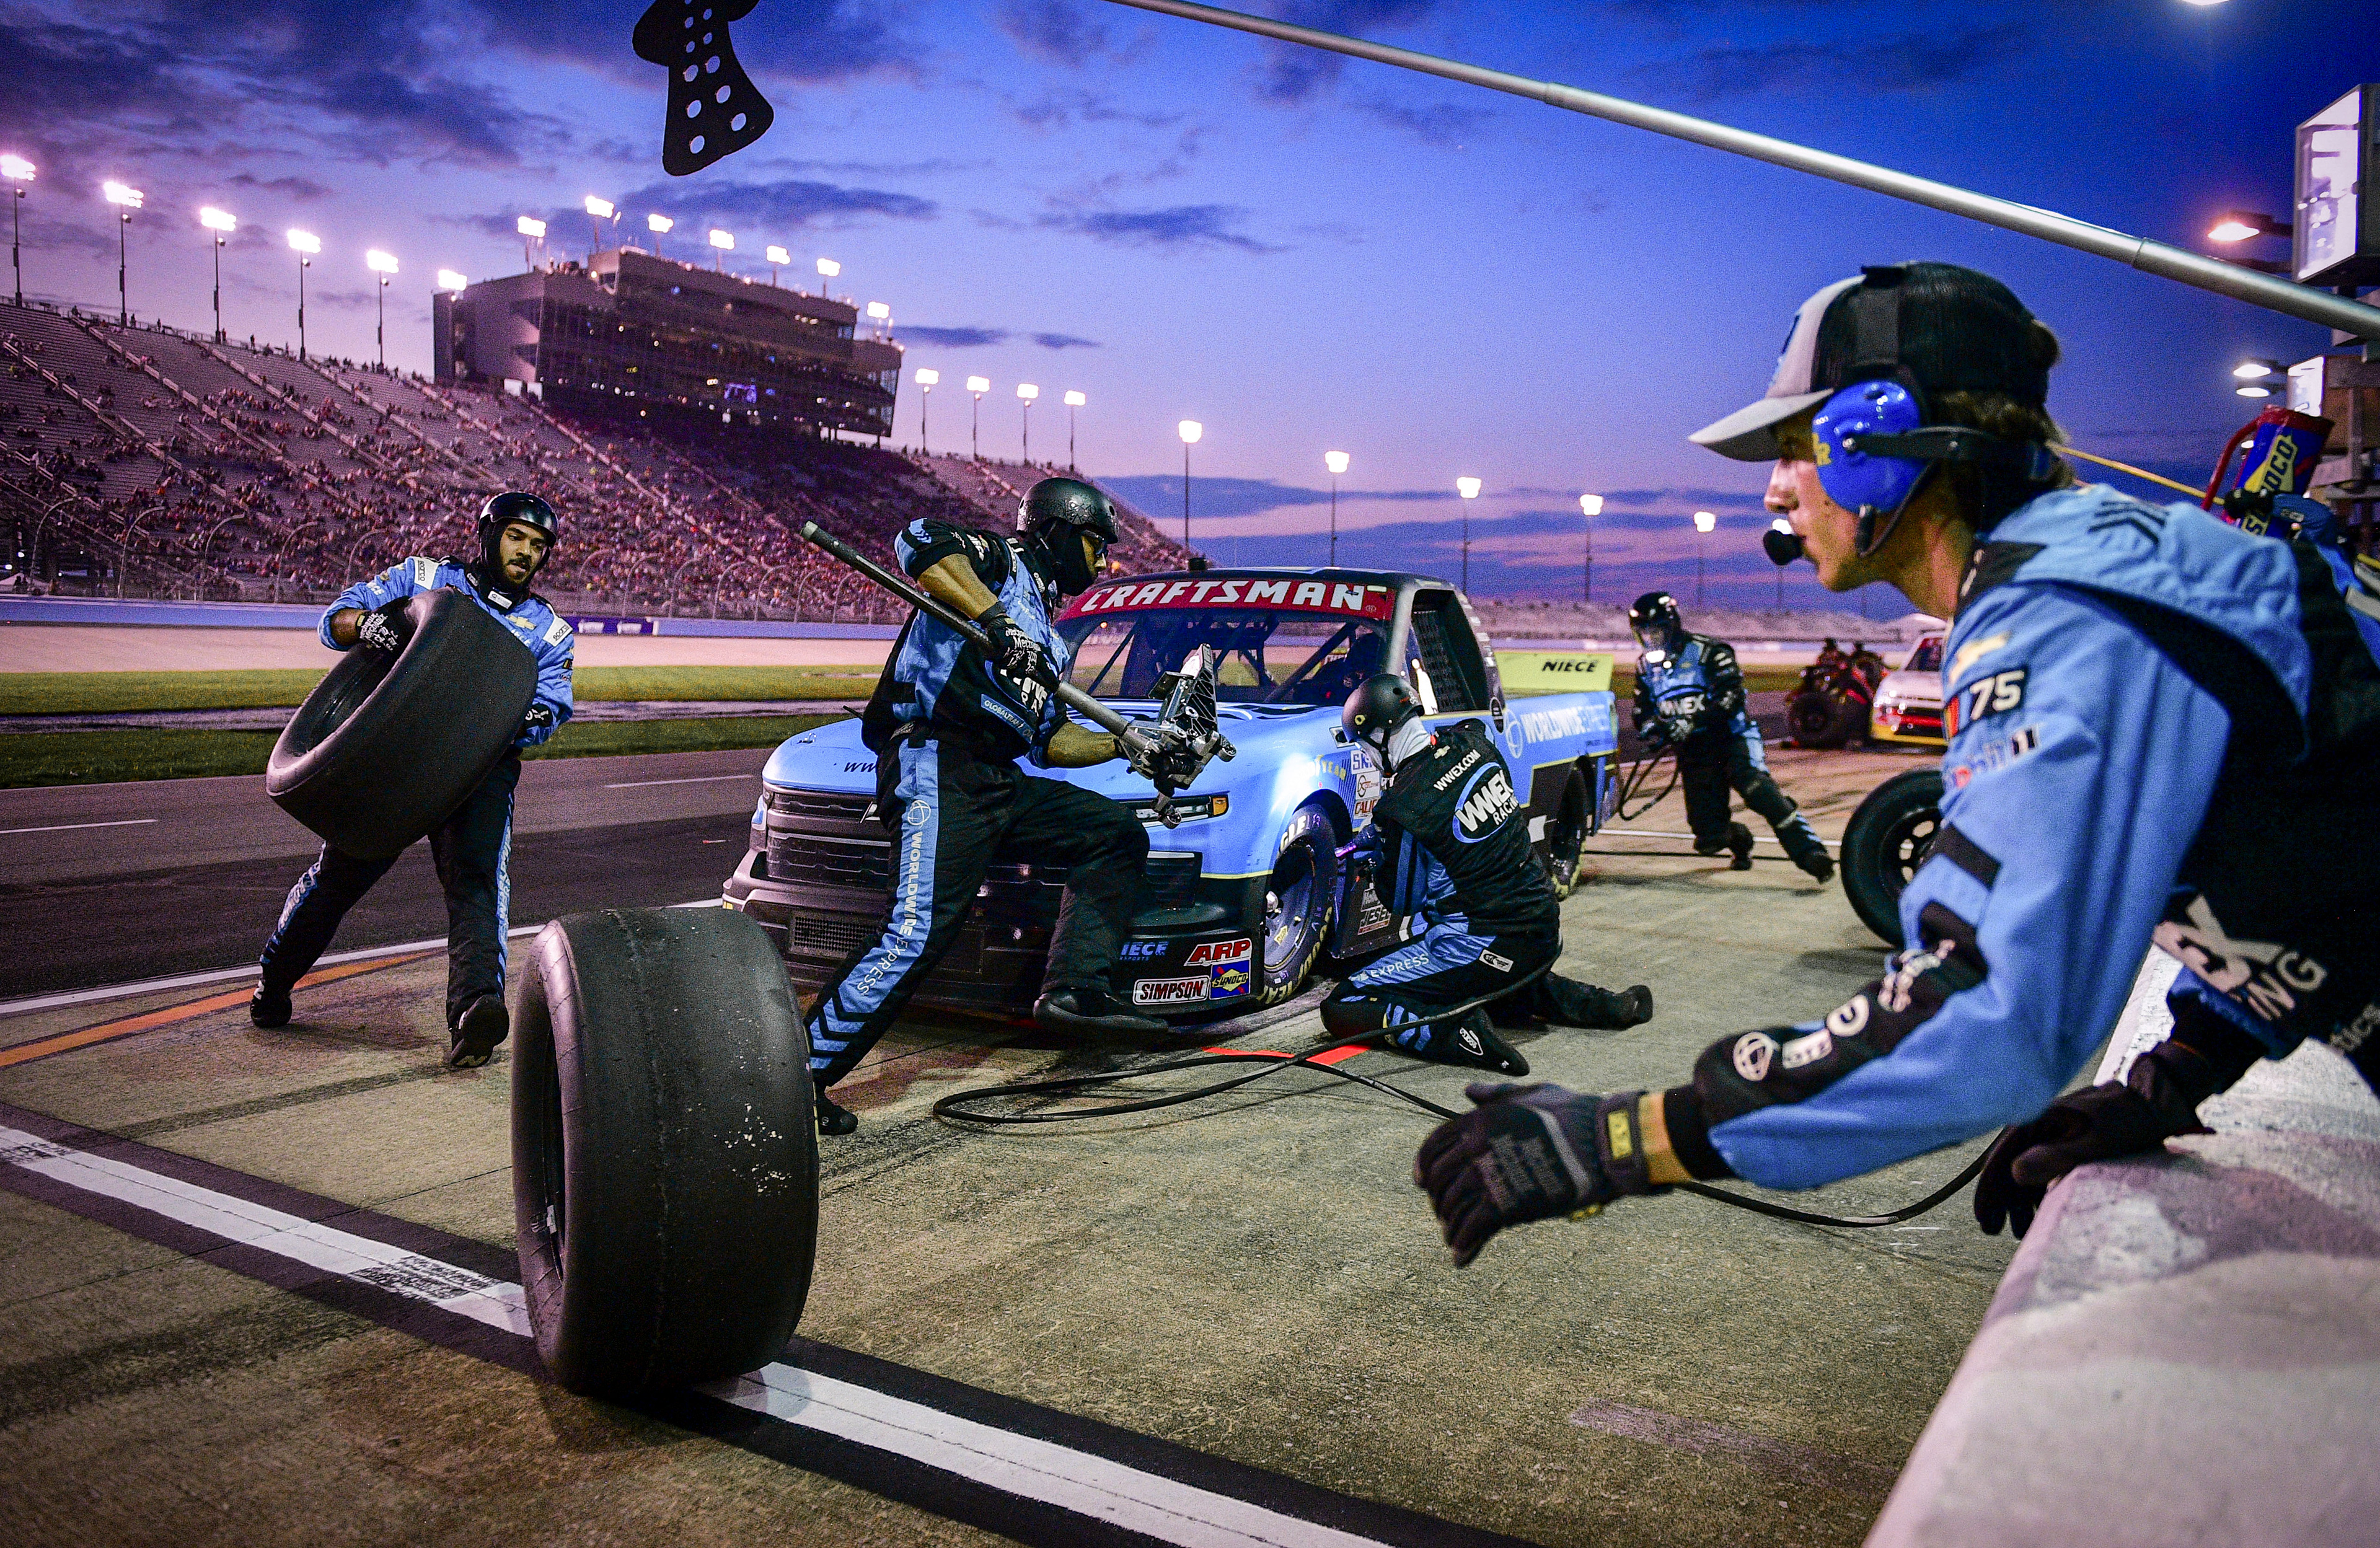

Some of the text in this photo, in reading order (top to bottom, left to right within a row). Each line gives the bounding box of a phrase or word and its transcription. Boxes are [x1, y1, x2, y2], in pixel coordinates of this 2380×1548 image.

[2245, 438, 2294, 536] SOCO
[1080, 580, 1365, 612] CRAFTSMAN
[1541, 661, 1598, 672] NIECE
[1968, 670, 2025, 720] 75
[1433, 749, 1482, 791] WWEX.COM
[1455, 769, 1514, 832] WWEX
[857, 831, 923, 996] WORLDWIDE EXPRESS
[1120, 941, 1170, 956] IECE
[1189, 939, 1251, 962] ARP
[1213, 973, 1250, 988] SUNOCO
[1370, 953, 1430, 979] EXPRESS
[1140, 980, 1205, 1001] SIMPSON
